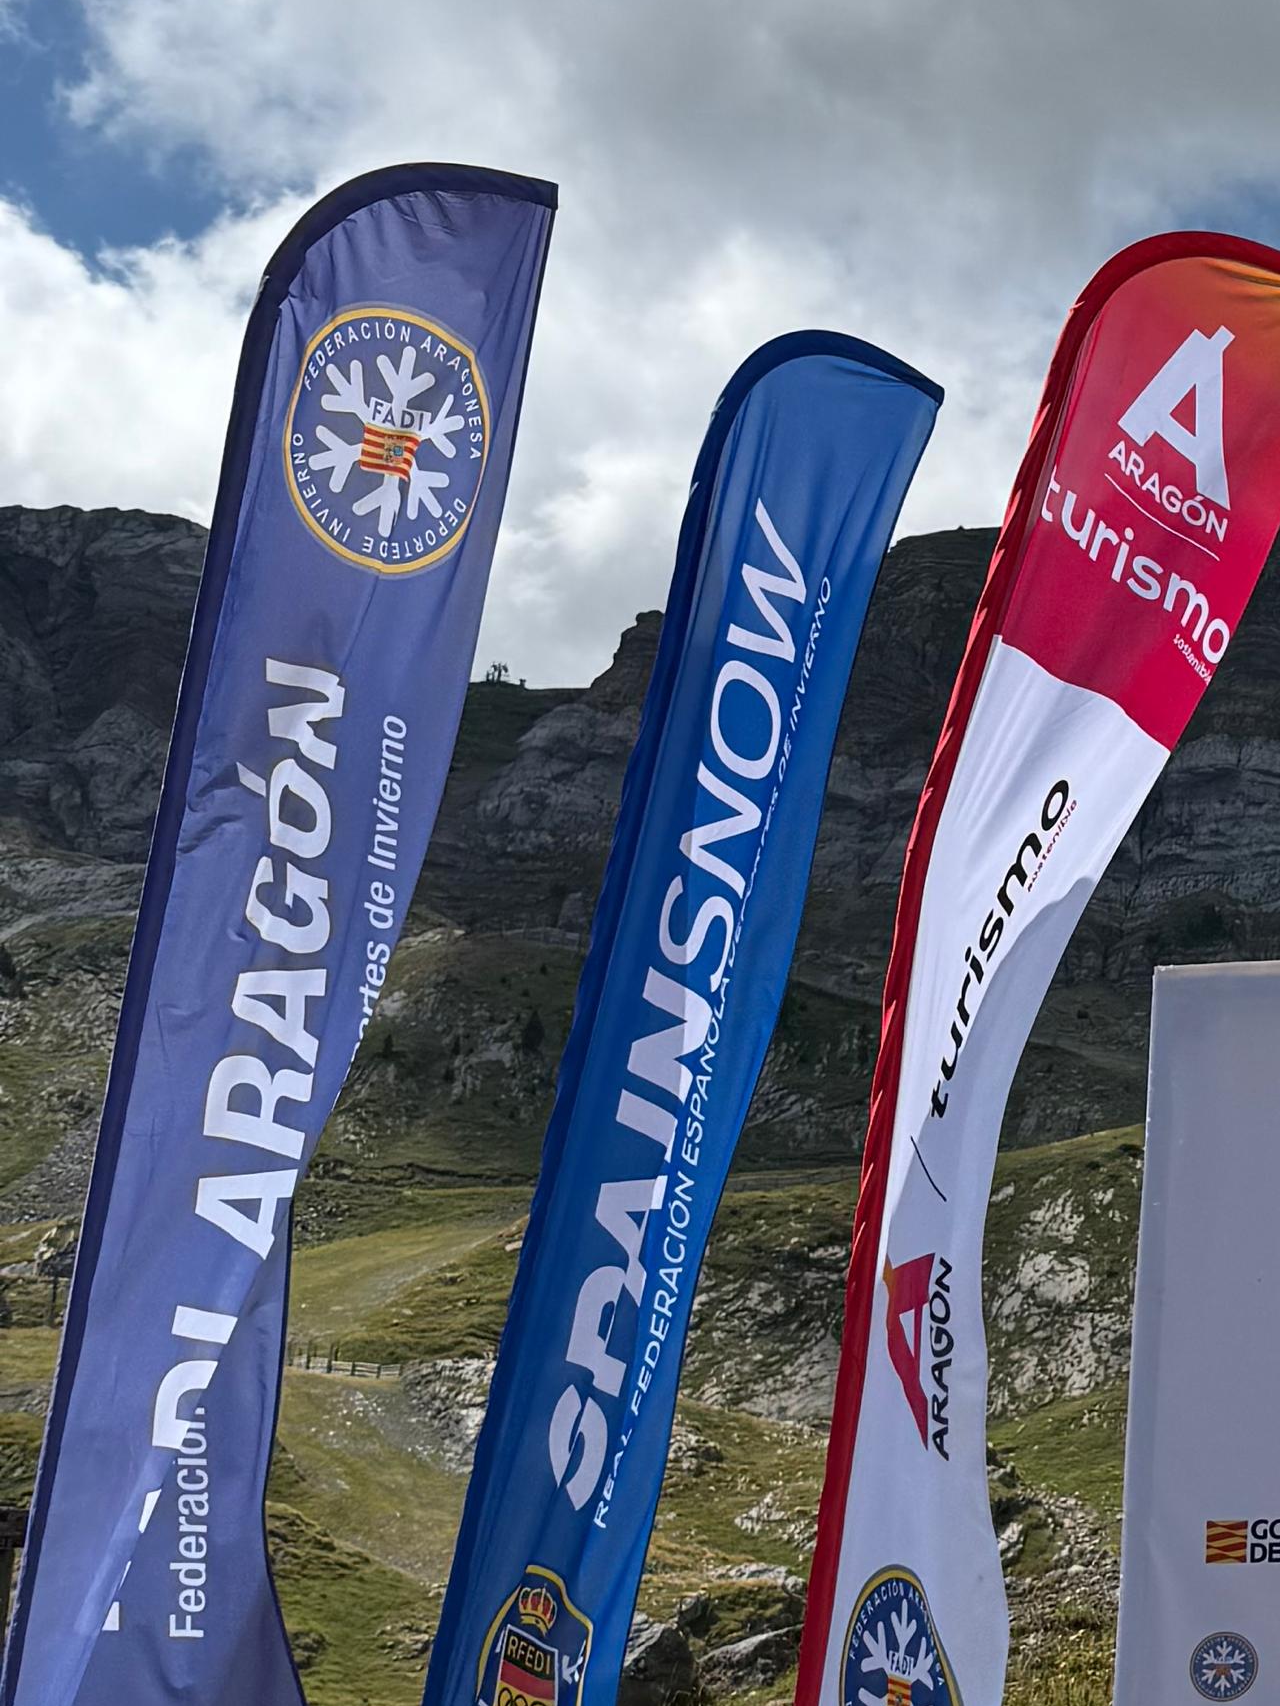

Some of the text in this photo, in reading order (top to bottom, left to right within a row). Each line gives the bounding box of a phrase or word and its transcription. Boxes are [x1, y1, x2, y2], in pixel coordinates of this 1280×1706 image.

[303, 318, 484, 461] FEDERACIÓN ARAGONESA
[371, 398, 426, 432] FADI
[293, 432, 351, 543] INVIERNO
[1107, 439, 1228, 544] ARAGÓN
[1041, 465, 1231, 665] turismo
[367, 714, 408, 872] Invierno
[195, 658, 346, 1260] ARAGÓN
[363, 881, 396, 930] de
[929, 778, 1071, 1120] turismo
[548, 497, 808, 1512] SPAINSNOW
[593, 1427, 634, 1530] REAL
[630, 1168, 697, 1417] FEDERACIÓN
[506, 1635, 552, 1675] RFEDI
